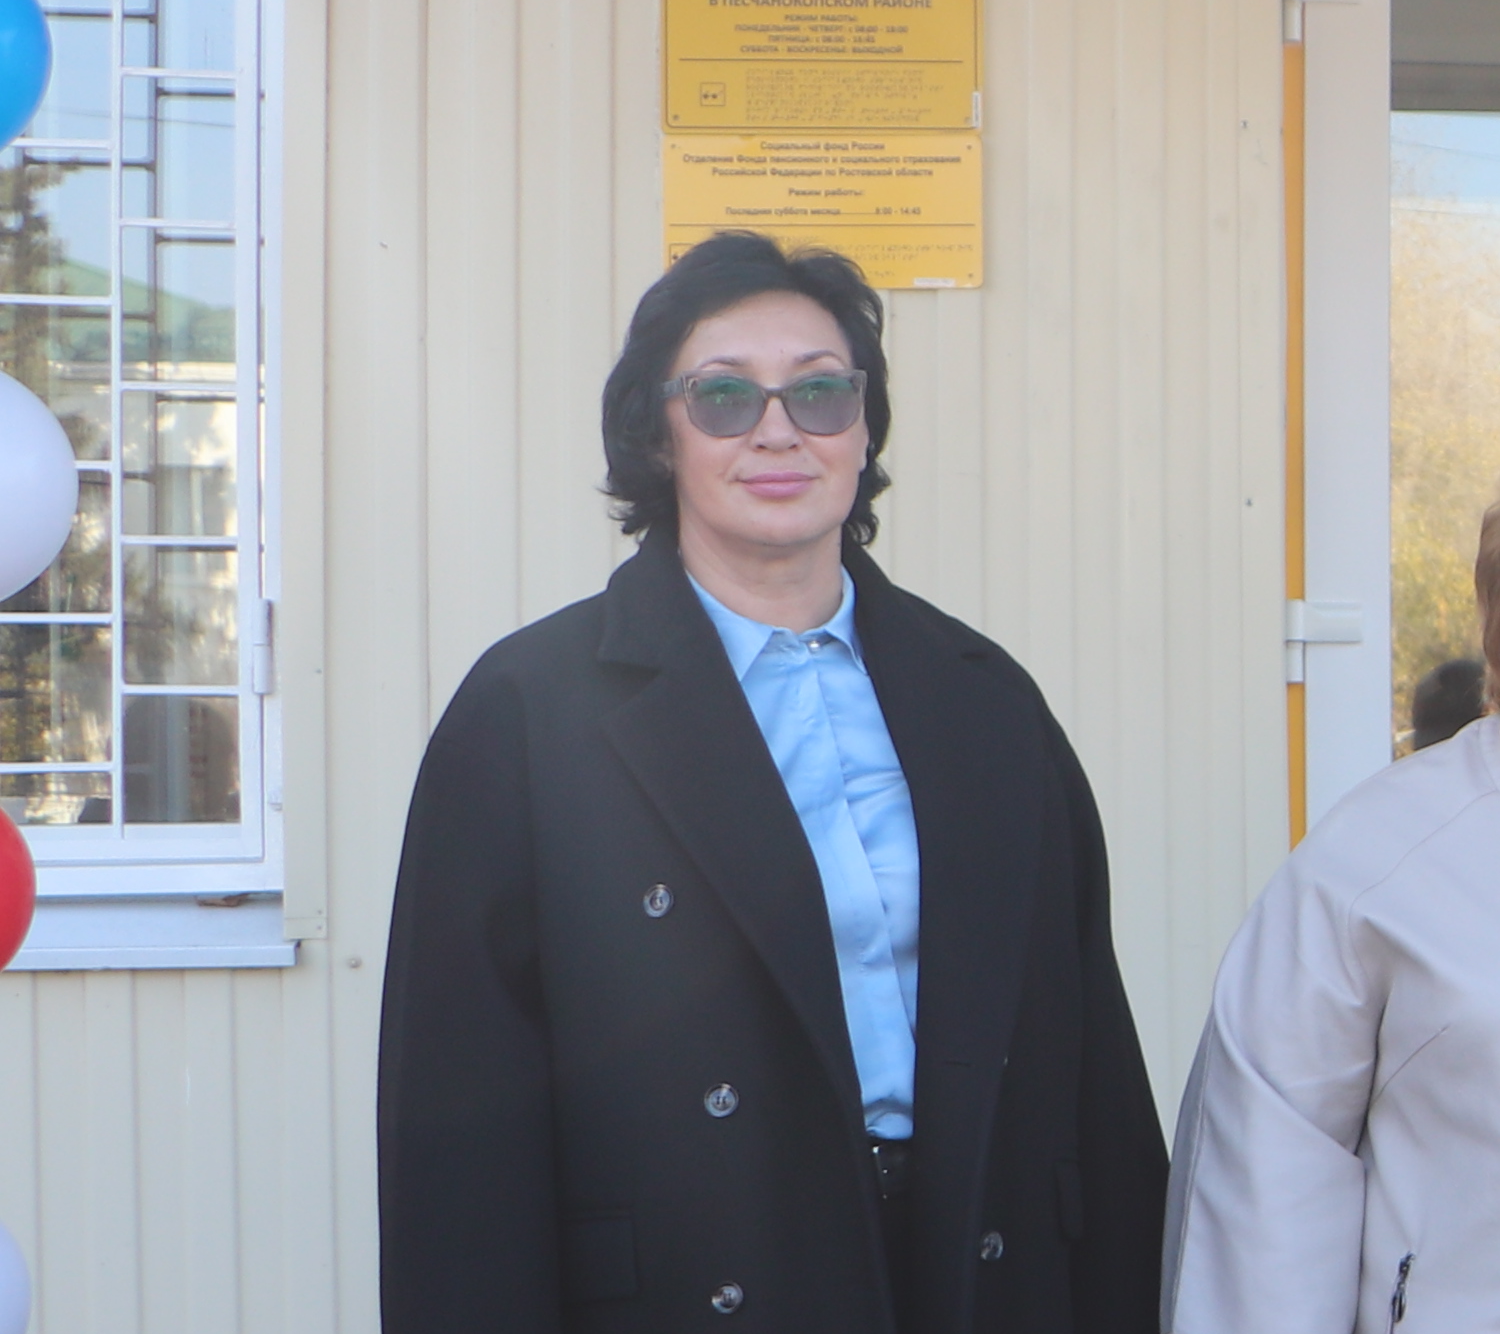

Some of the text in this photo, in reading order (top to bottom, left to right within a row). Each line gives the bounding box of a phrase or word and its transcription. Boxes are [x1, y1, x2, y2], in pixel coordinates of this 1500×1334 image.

[760, 141, 885, 152] Социальный фонд России
[683, 154, 734, 164] Отделение
[736, 154, 767, 164] Фонда
[770, 156, 830, 164] пенсионного
[840, 156, 900, 164] социального
[903, 156, 961, 165] страхования
[712, 167, 767, 176] Российской
[770, 168, 822, 178] Федерации
[839, 167, 893, 177] Ростовской
[895, 167, 933, 177] области
[788, 188, 865, 198] Режим работы:
[726, 207, 771, 216] Последняя
[774, 206, 808, 217] суббота
[811, 208, 840, 216] месяца
